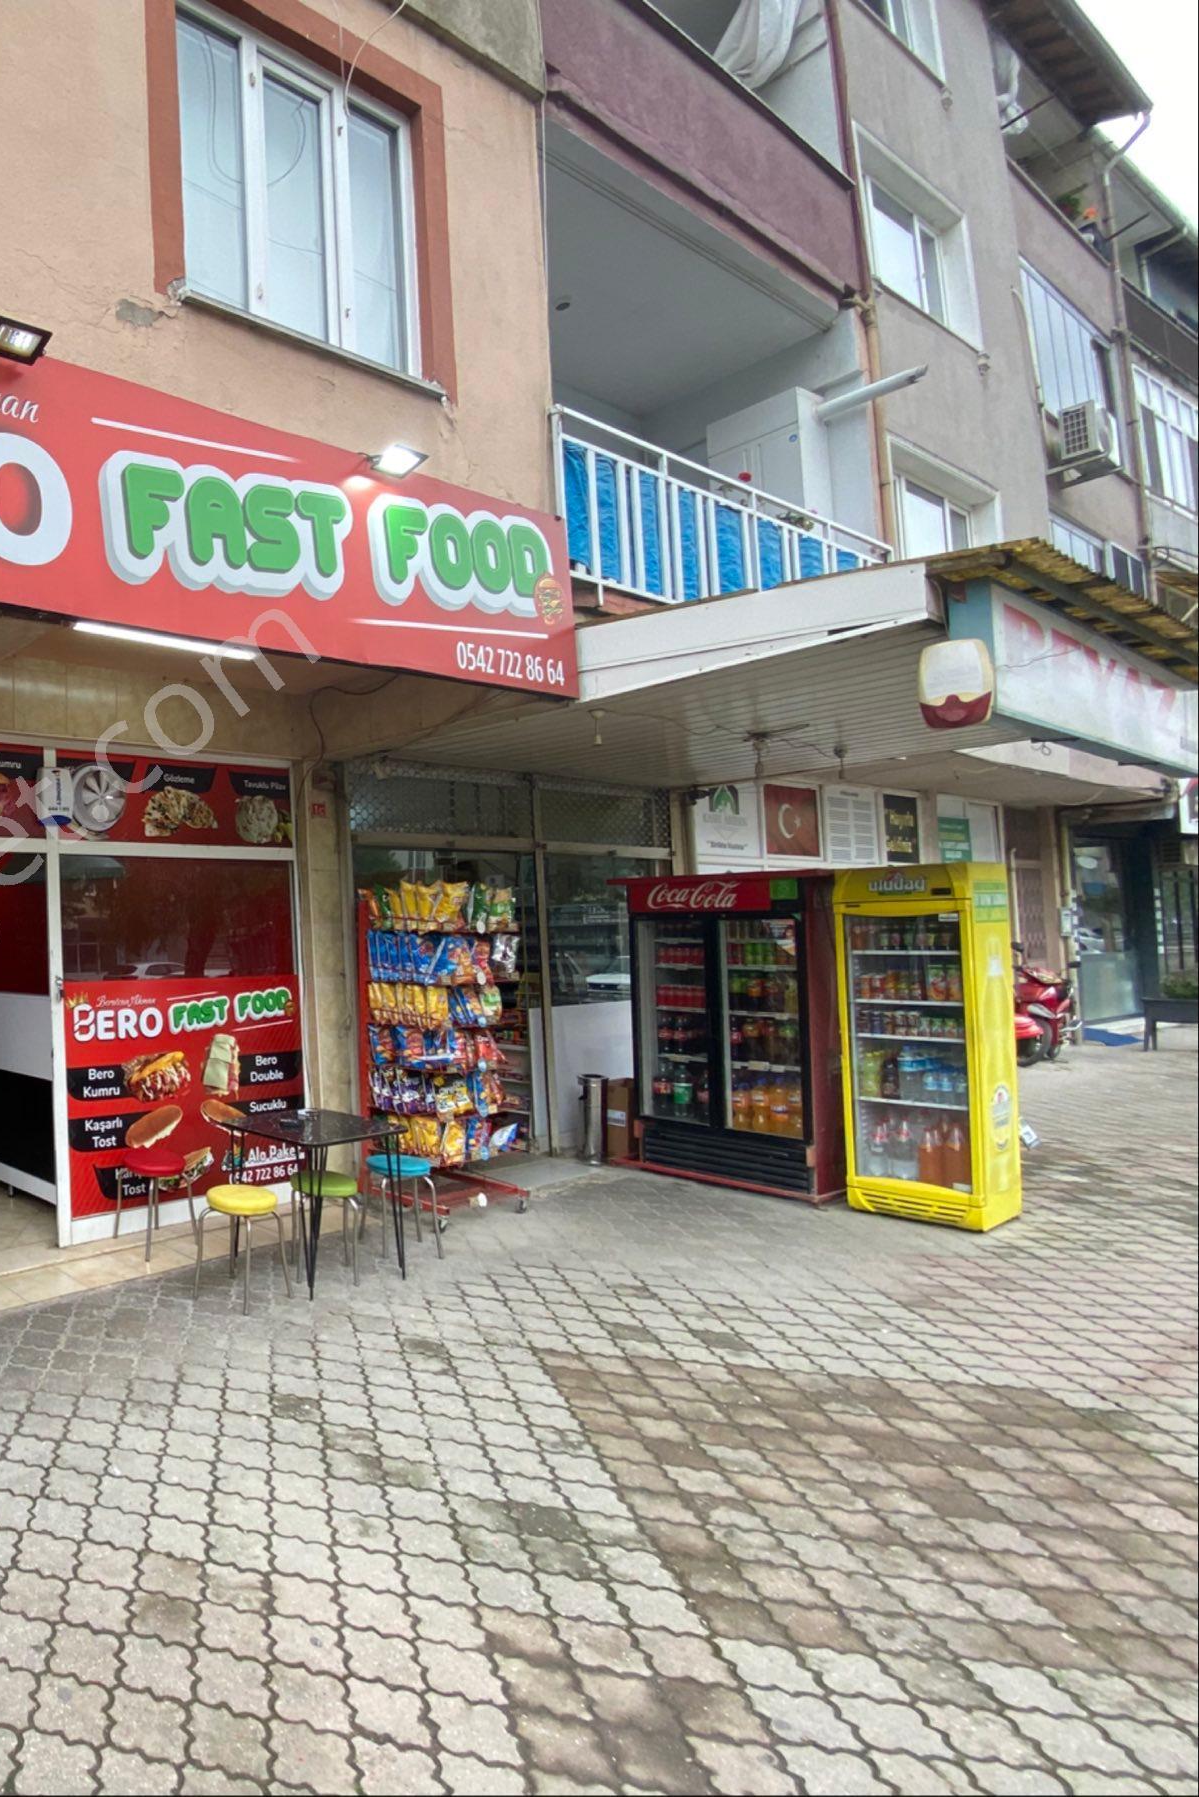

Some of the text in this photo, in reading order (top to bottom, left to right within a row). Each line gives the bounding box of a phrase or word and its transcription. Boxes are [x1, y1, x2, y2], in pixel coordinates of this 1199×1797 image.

[107, 455, 552, 608] FAST FOOD
[456, 641, 565, 687] 0542 722 86 64
[73, 988, 292, 1042] BERO FAST FOOD
[255, 1055, 278, 1067] Bero
[88, 1068, 114, 1080] Bero
[250, 1070, 284, 1083] Double
[83, 1085, 120, 1098] Kumru
[250, 1101, 287, 1113] Sucuklu
[85, 1118, 123, 1132] Kaşarlı
[92, 1135, 117, 1148] Tost
[248, 1143, 302, 1161] Alo Pake
[255, 1168, 272, 1181] 722
[273, 1165, 286, 1177] 86
[122, 1183, 146, 1196] Tost
